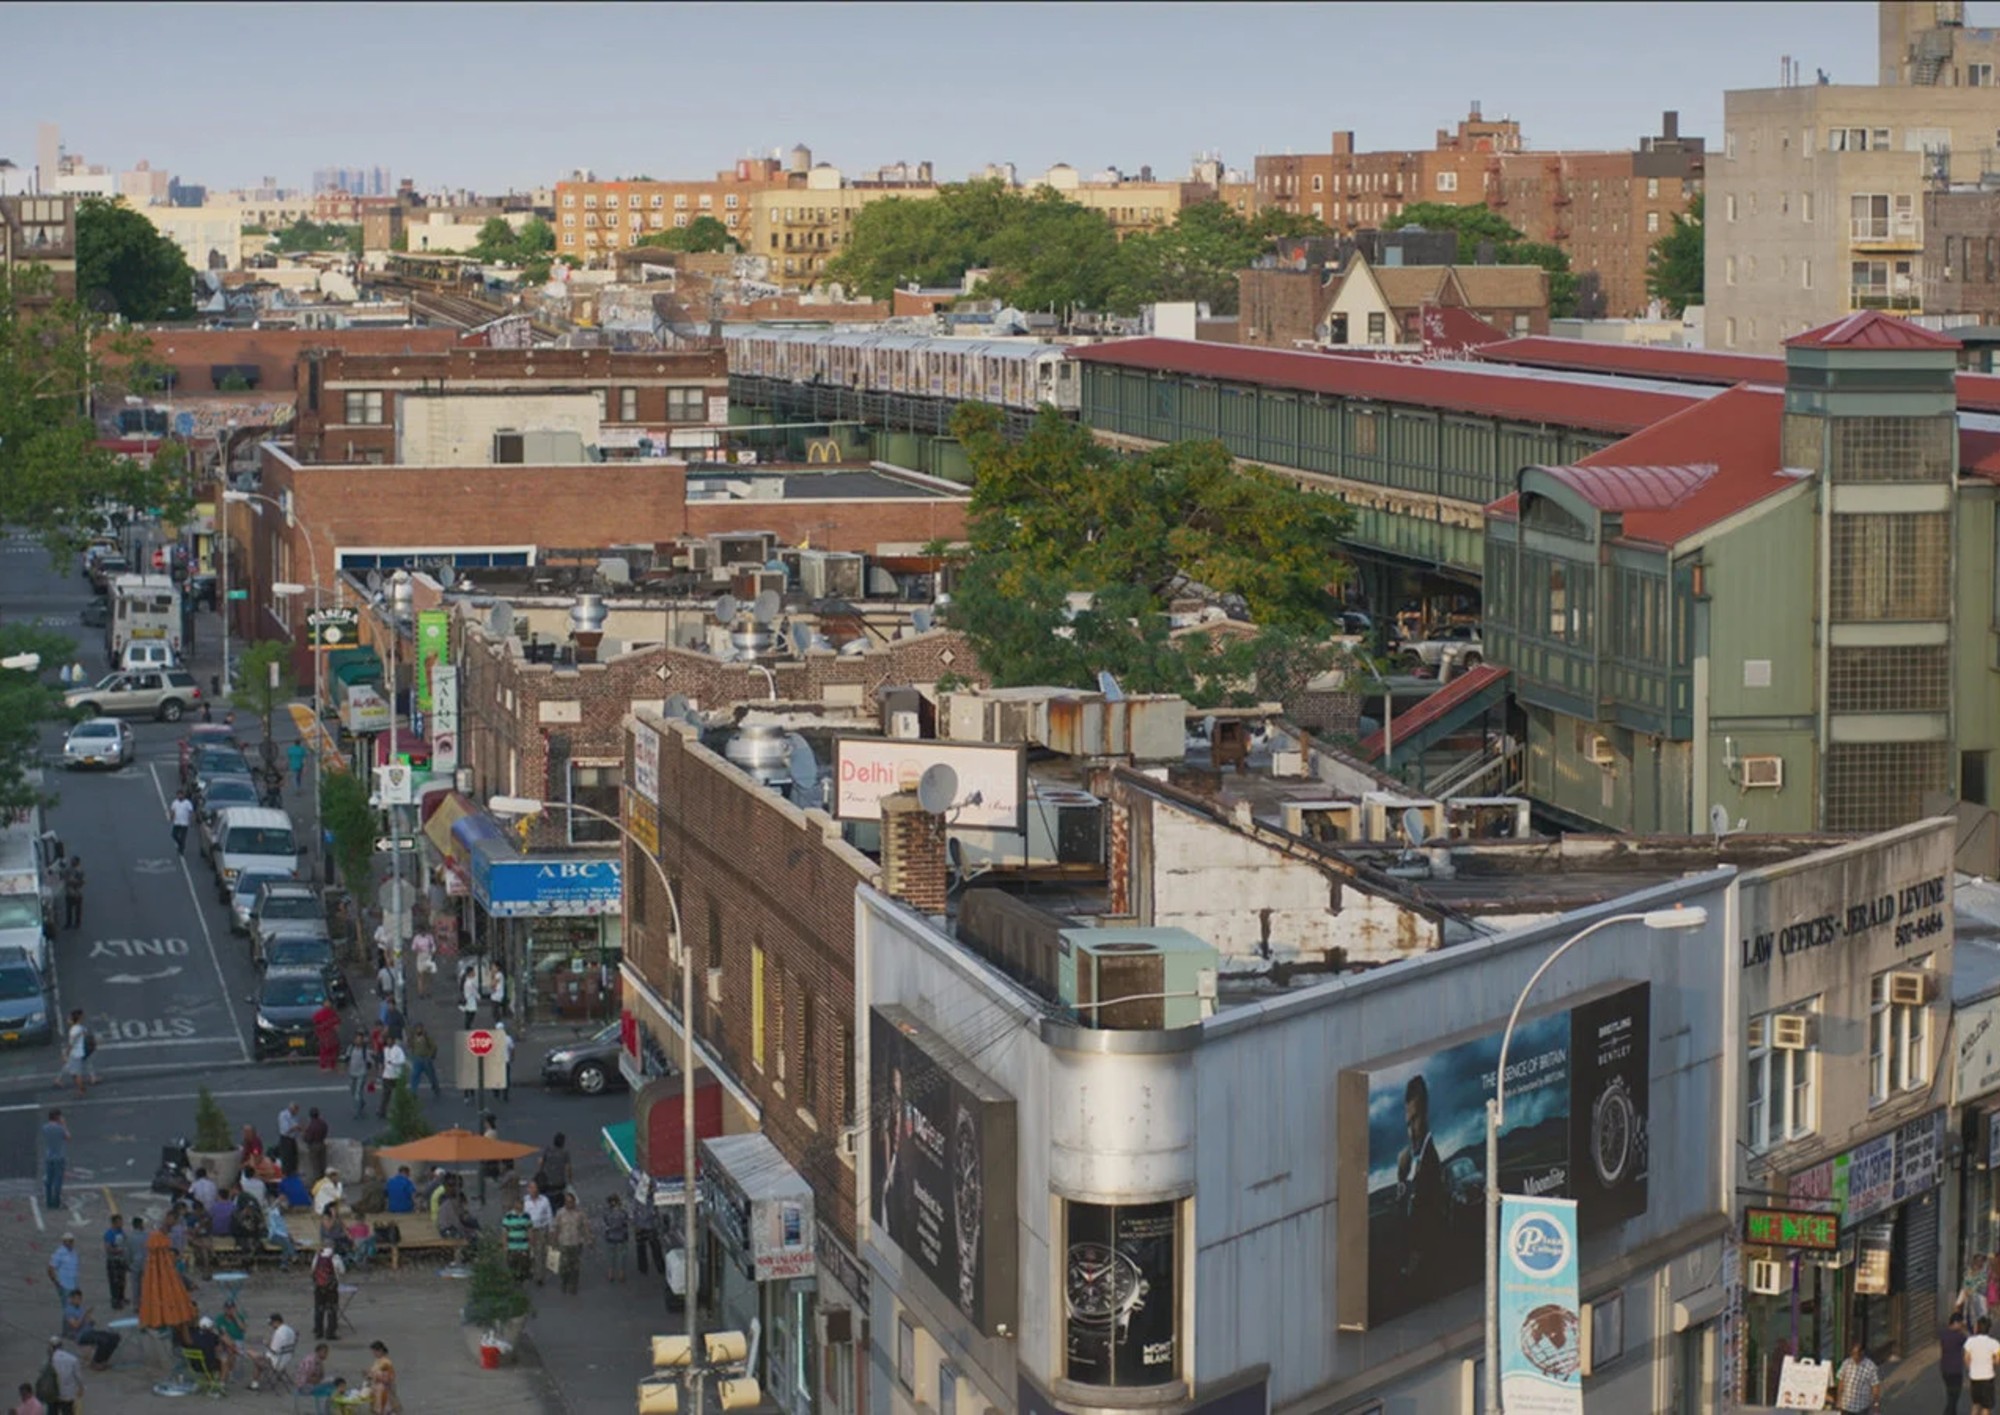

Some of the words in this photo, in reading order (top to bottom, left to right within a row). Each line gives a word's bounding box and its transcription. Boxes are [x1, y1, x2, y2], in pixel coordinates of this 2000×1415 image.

[841, 760, 894, 784] Delhi
[1742, 931, 1774, 969] LAW
[1779, 914, 1835, 957] OFFICES
[1843, 894, 1895, 937] JERALD
[1898, 876, 1946, 917] LEVINE
[89, 937, 190, 958] ONLY
[470, 1037, 492, 1048] STOP
[1598, 1044, 1632, 1067] BENTLEY
[1142, 1351, 1172, 1365] BLANC
